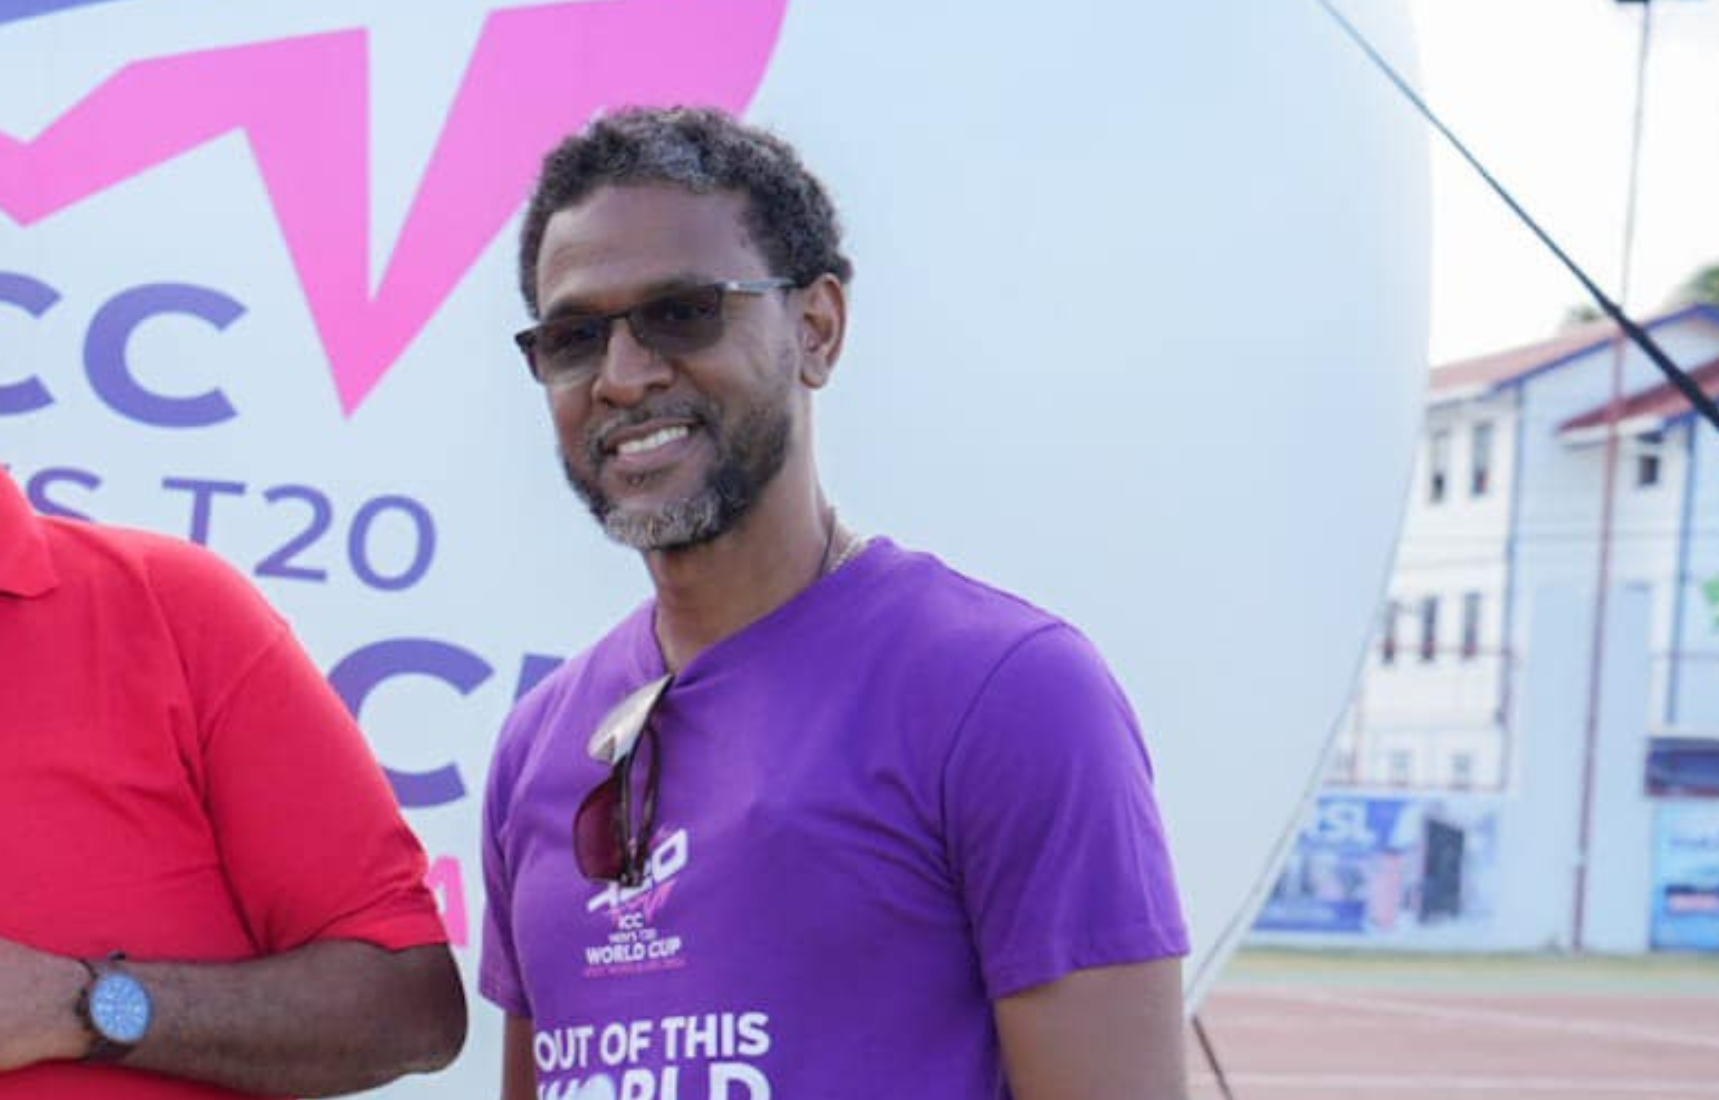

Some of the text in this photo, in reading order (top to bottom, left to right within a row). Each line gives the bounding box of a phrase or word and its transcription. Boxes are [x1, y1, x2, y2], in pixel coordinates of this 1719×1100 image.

[161, 477, 437, 591] T20
[585, 942, 645, 966] WORLD
[648, 936, 681, 960] CUP
[534, 1011, 771, 1072] OUT OF THIS
